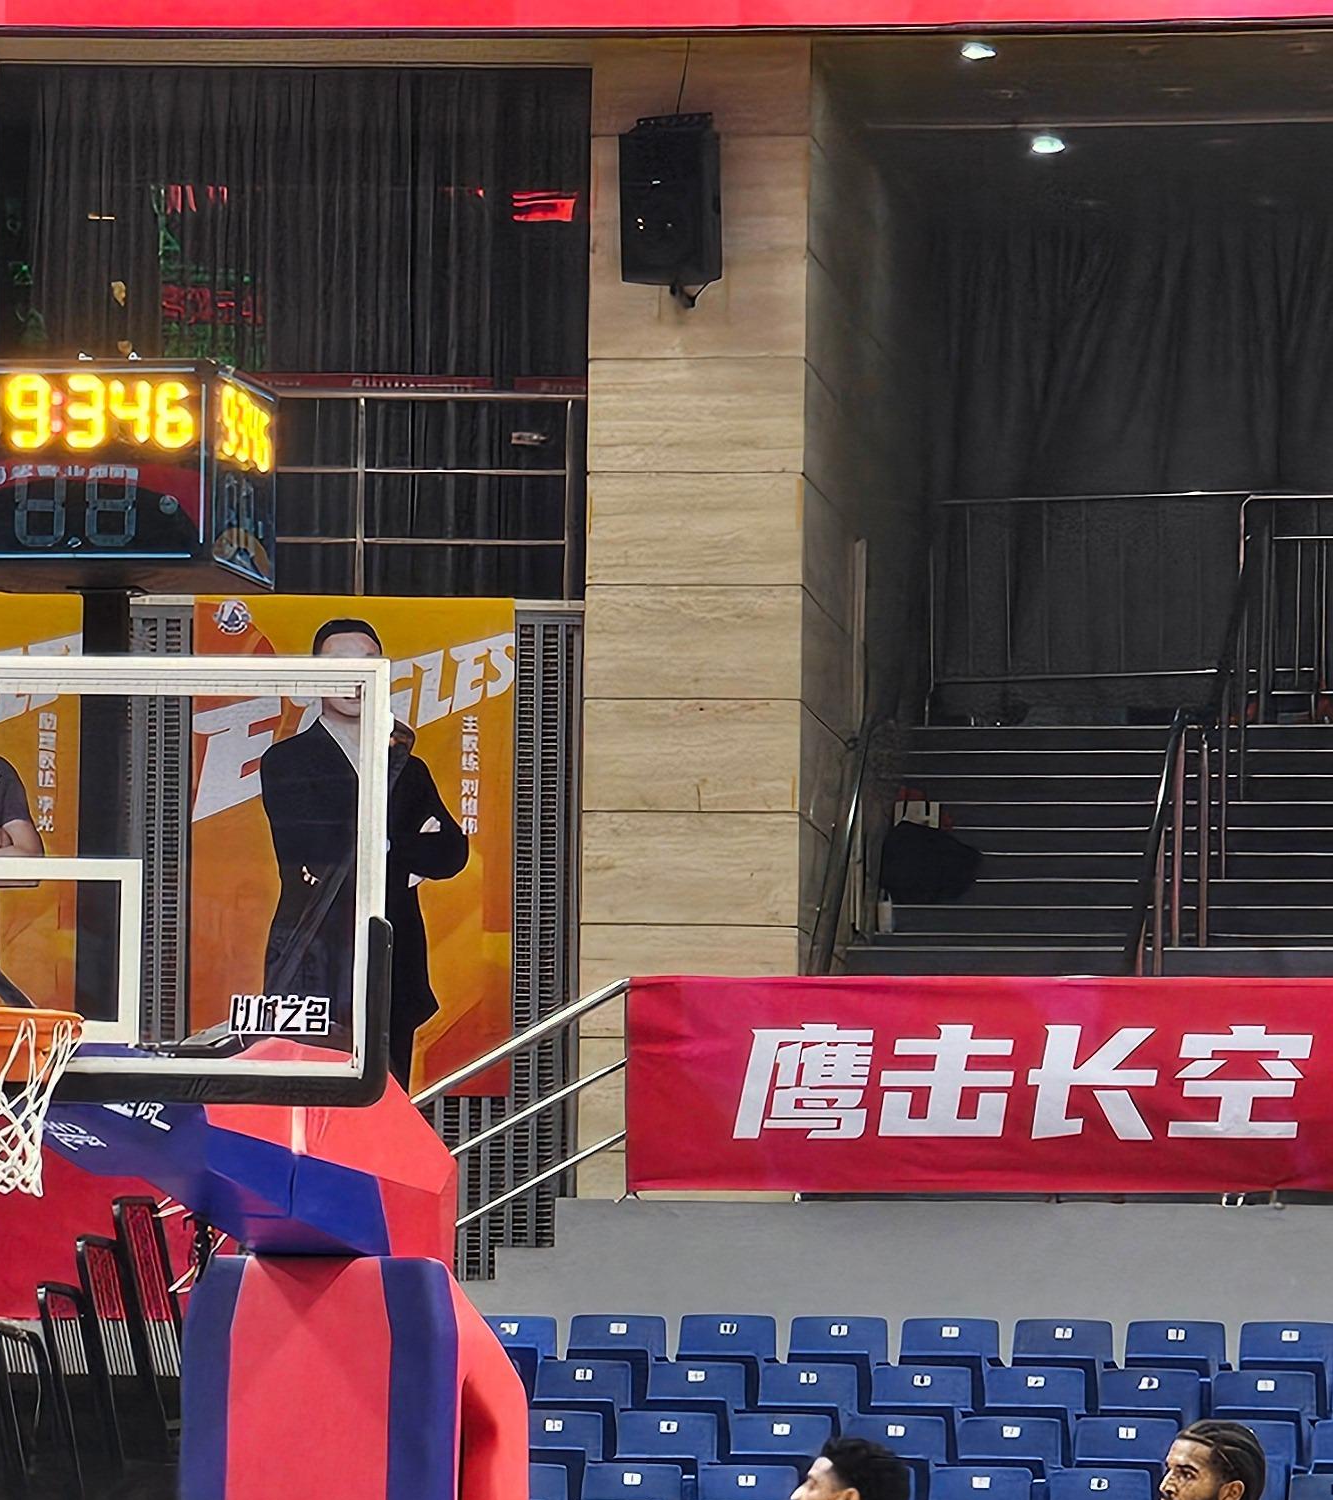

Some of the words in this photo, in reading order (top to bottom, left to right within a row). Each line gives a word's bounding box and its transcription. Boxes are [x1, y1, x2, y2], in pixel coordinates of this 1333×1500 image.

[192, 633, 515, 822] ELES
[733, 1024, 1314, 1140] 鹰击长空
